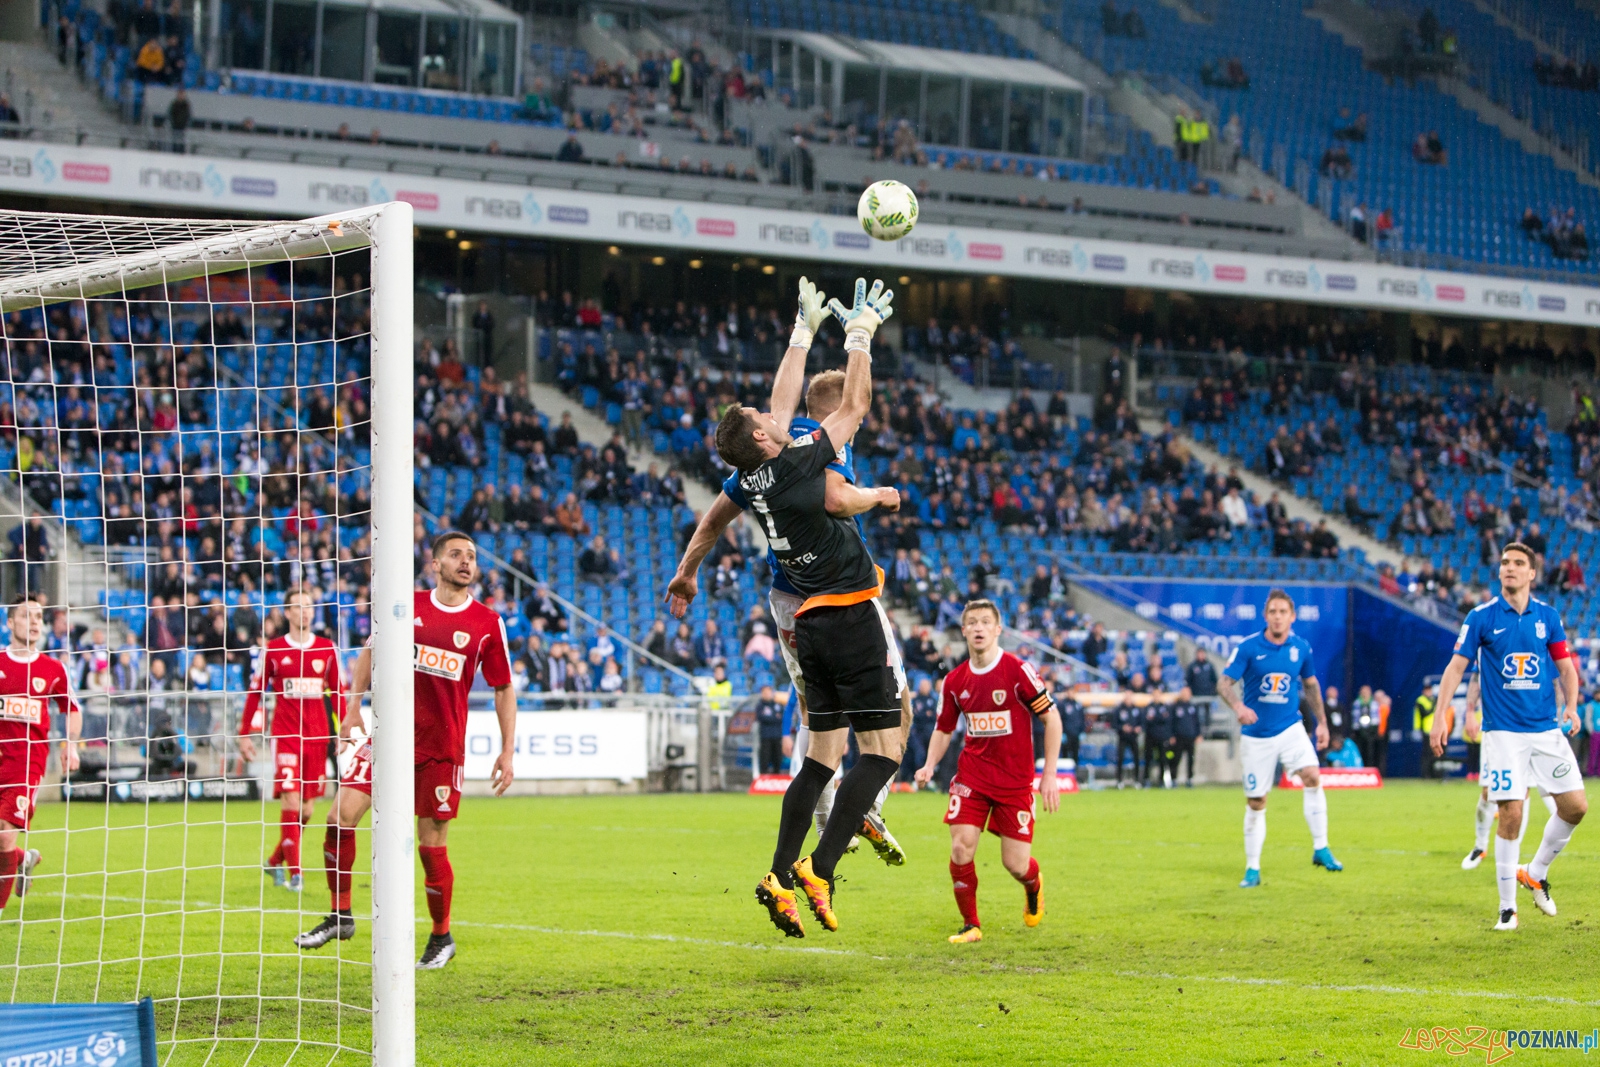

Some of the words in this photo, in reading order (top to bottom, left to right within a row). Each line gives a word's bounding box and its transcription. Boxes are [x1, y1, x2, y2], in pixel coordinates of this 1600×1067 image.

[752, 494, 792, 551] 1
[1501, 652, 1540, 680] STS
[1259, 672, 1291, 695] STS
[281, 767, 295, 789] 2
[1491, 769, 1512, 792] 35
[947, 794, 961, 820] 9
